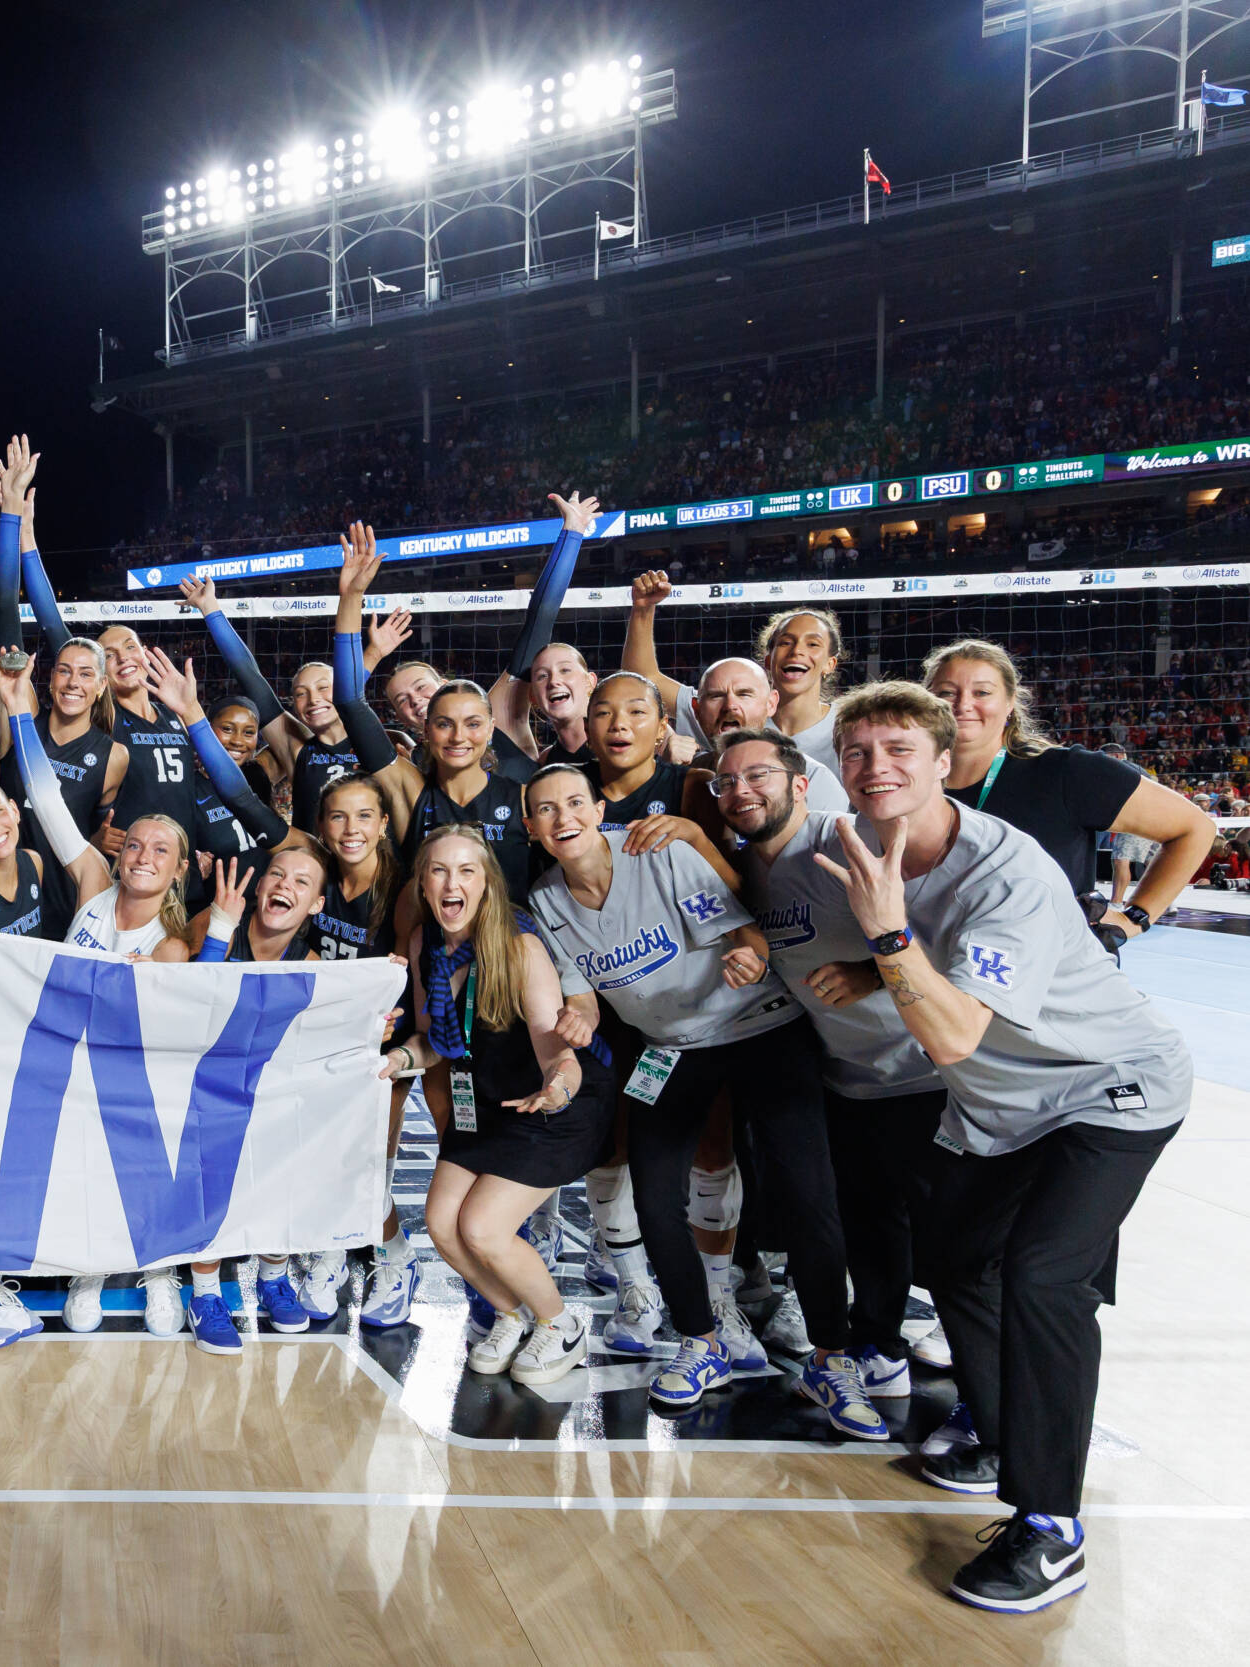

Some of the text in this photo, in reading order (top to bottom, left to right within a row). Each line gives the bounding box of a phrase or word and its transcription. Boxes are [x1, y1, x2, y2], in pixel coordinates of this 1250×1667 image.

[1045, 461, 1084, 473] TIMEOUTS
[1126, 453, 1190, 472] Welcome
[1191, 451, 1210, 464] to
[985, 470, 1001, 491] 0
[1045, 469, 1094, 482] CHALLENGES
[888, 482, 902, 501] 0
[928, 477, 961, 496] PSU
[769, 495, 800, 505] TIMEOUTS
[840, 488, 861, 505] UK
[680, 508, 694, 521] UK
[696, 505, 729, 520] LEADS
[760, 503, 800, 515] CHALLENGES
[629, 512, 668, 528] FINAL
[400, 527, 530, 555] KENTUCKY WILDCATS
[195, 554, 304, 579] KENTUCKY WILDCATS
[1201, 567, 1240, 578] Allstate
[826, 582, 865, 593] Allstate
[1012, 575, 1051, 586] Allstate
[289, 600, 327, 610] Allstate
[466, 594, 503, 604] Allstate
[117, 604, 153, 614] Allstate
[131, 732, 189, 746] KENTUCKY
[152, 747, 184, 783] 15
[680, 892, 726, 923] UK
[320, 936, 359, 960] 27
[576, 922, 671, 977] Kentucky
[971, 944, 1012, 986] UK
[606, 971, 645, 988] VOLLEYBALL
[1113, 1086, 1135, 1096] XL
